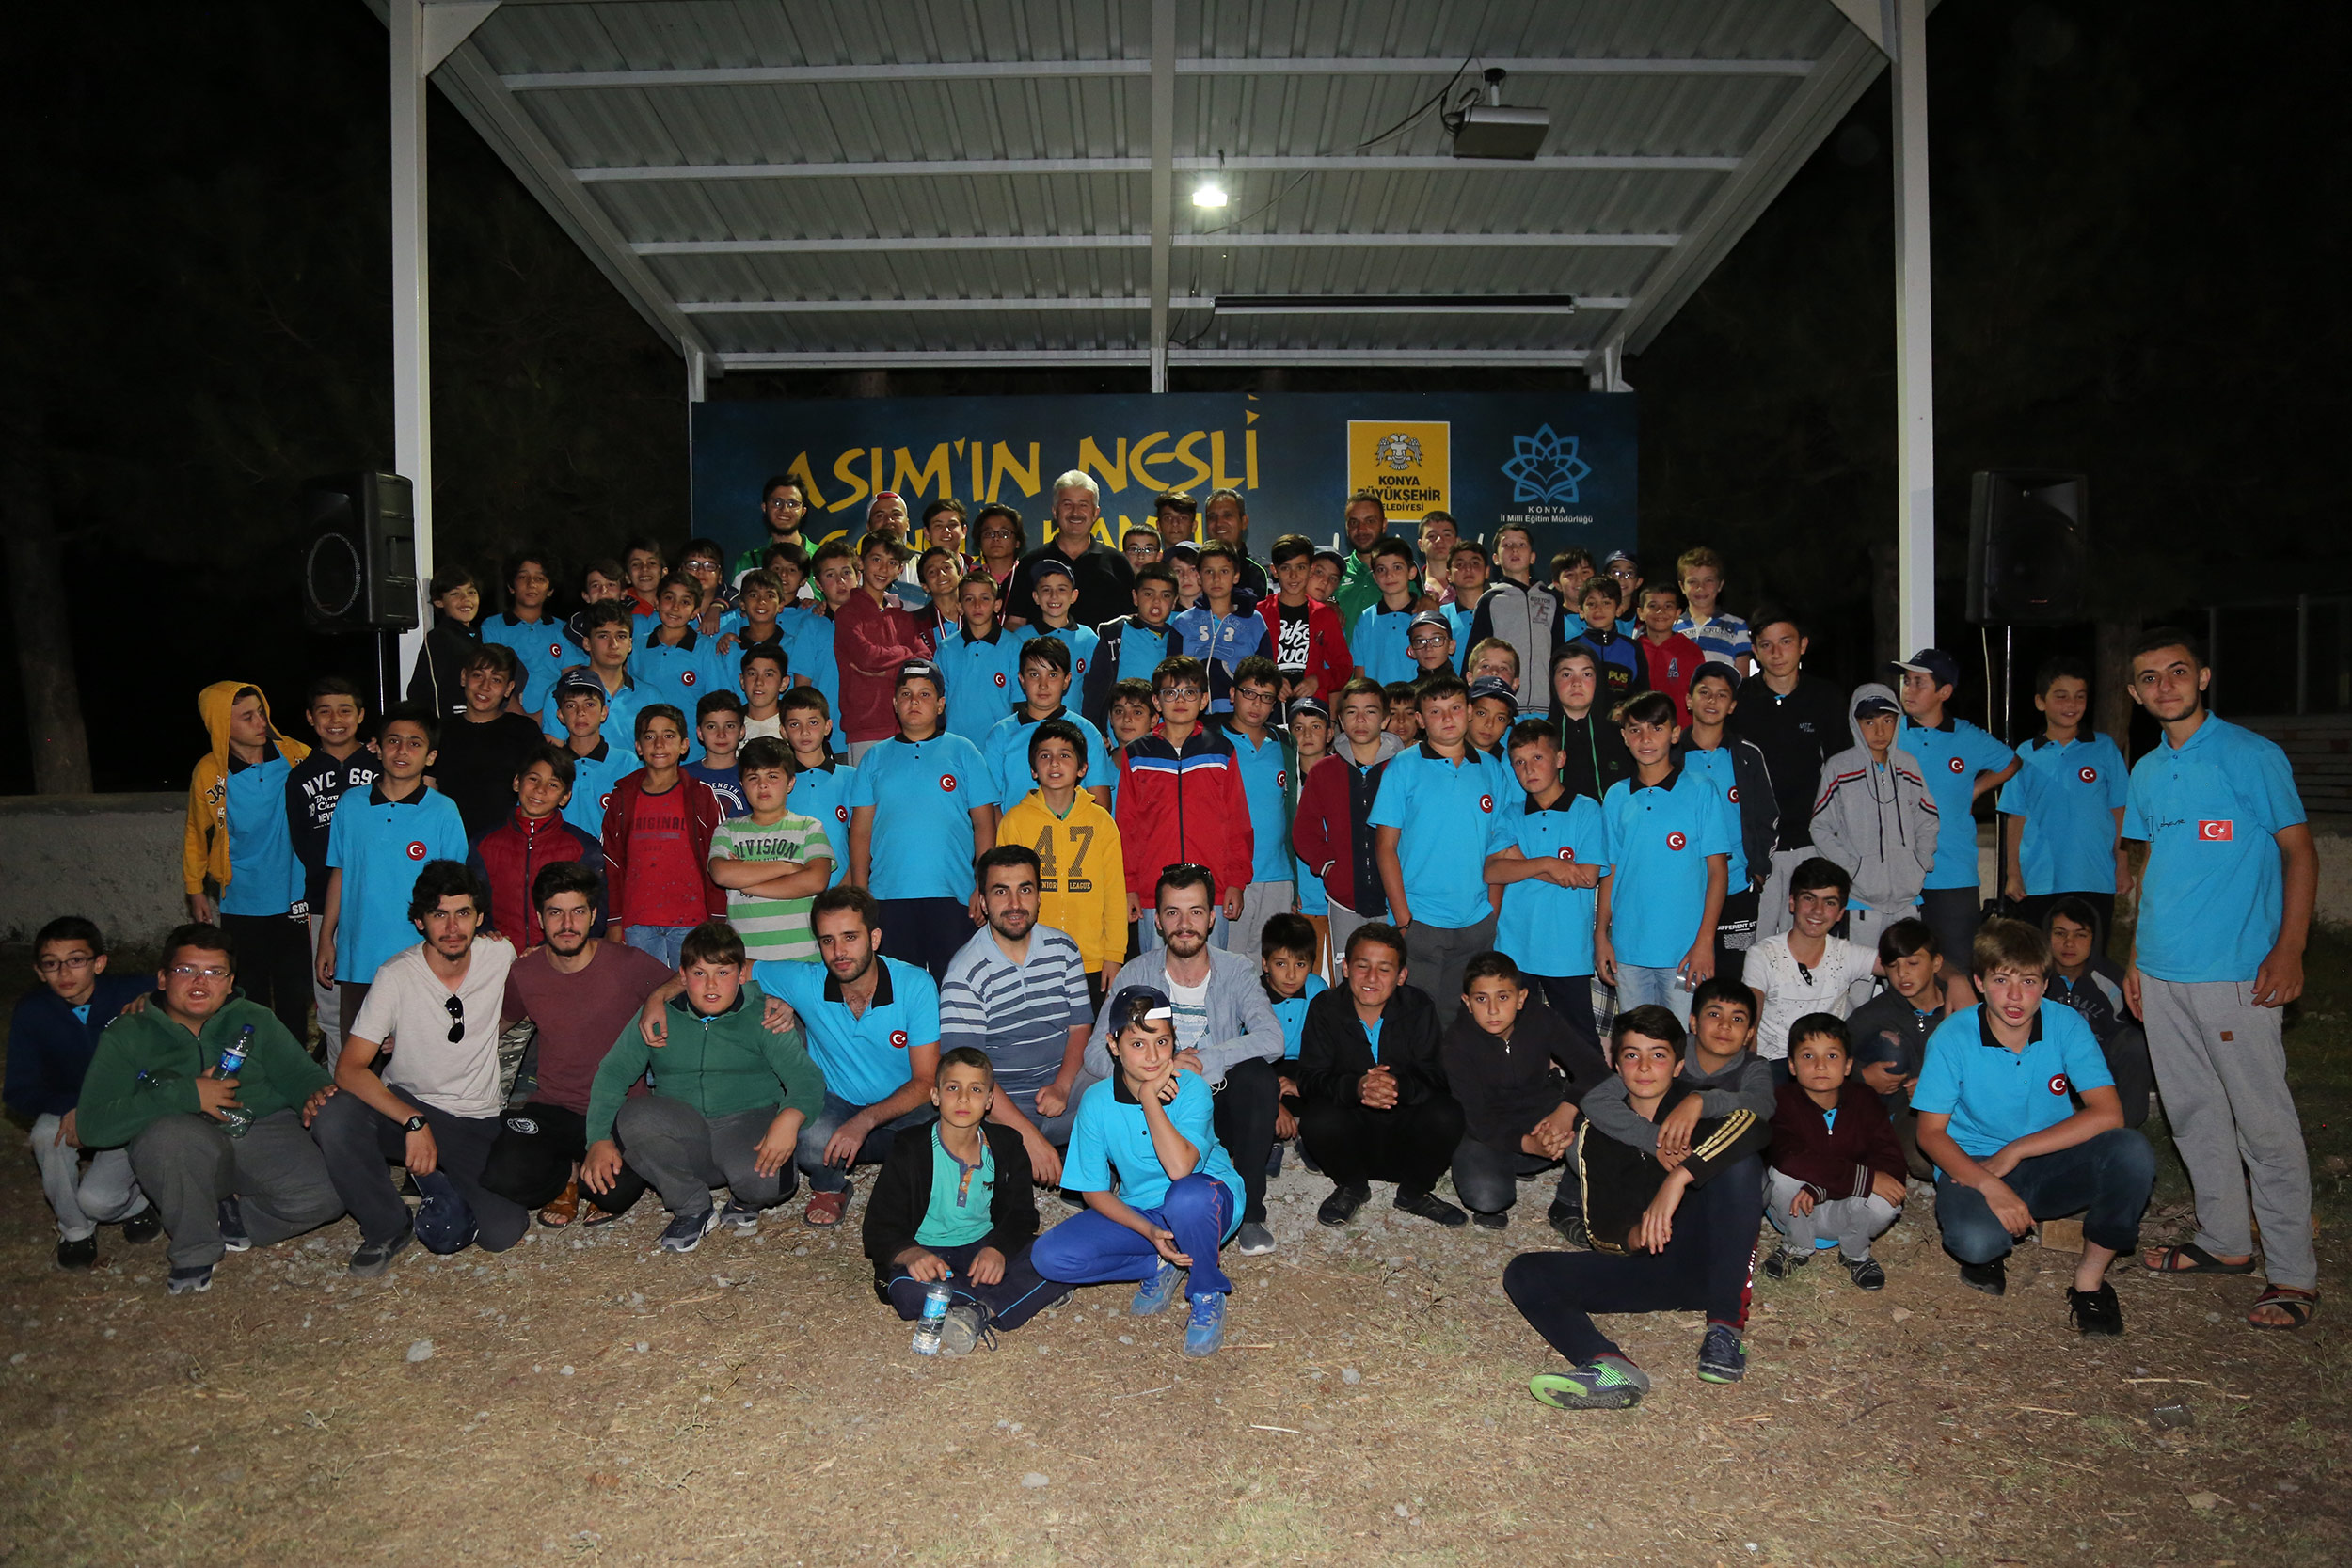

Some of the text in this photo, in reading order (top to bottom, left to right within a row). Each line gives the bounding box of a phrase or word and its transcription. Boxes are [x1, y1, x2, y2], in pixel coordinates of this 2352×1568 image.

[787, 397, 1260, 513] ASIM'IN NESLİ
[1378, 476, 1420, 485] KONYA
[1382, 503, 1424, 512] ELEDİYESİ
[1525, 515, 1550, 524] Eğitim
[1551, 515, 1594, 524] Müdürlüğü
[302, 768, 380, 799] NYC 69
